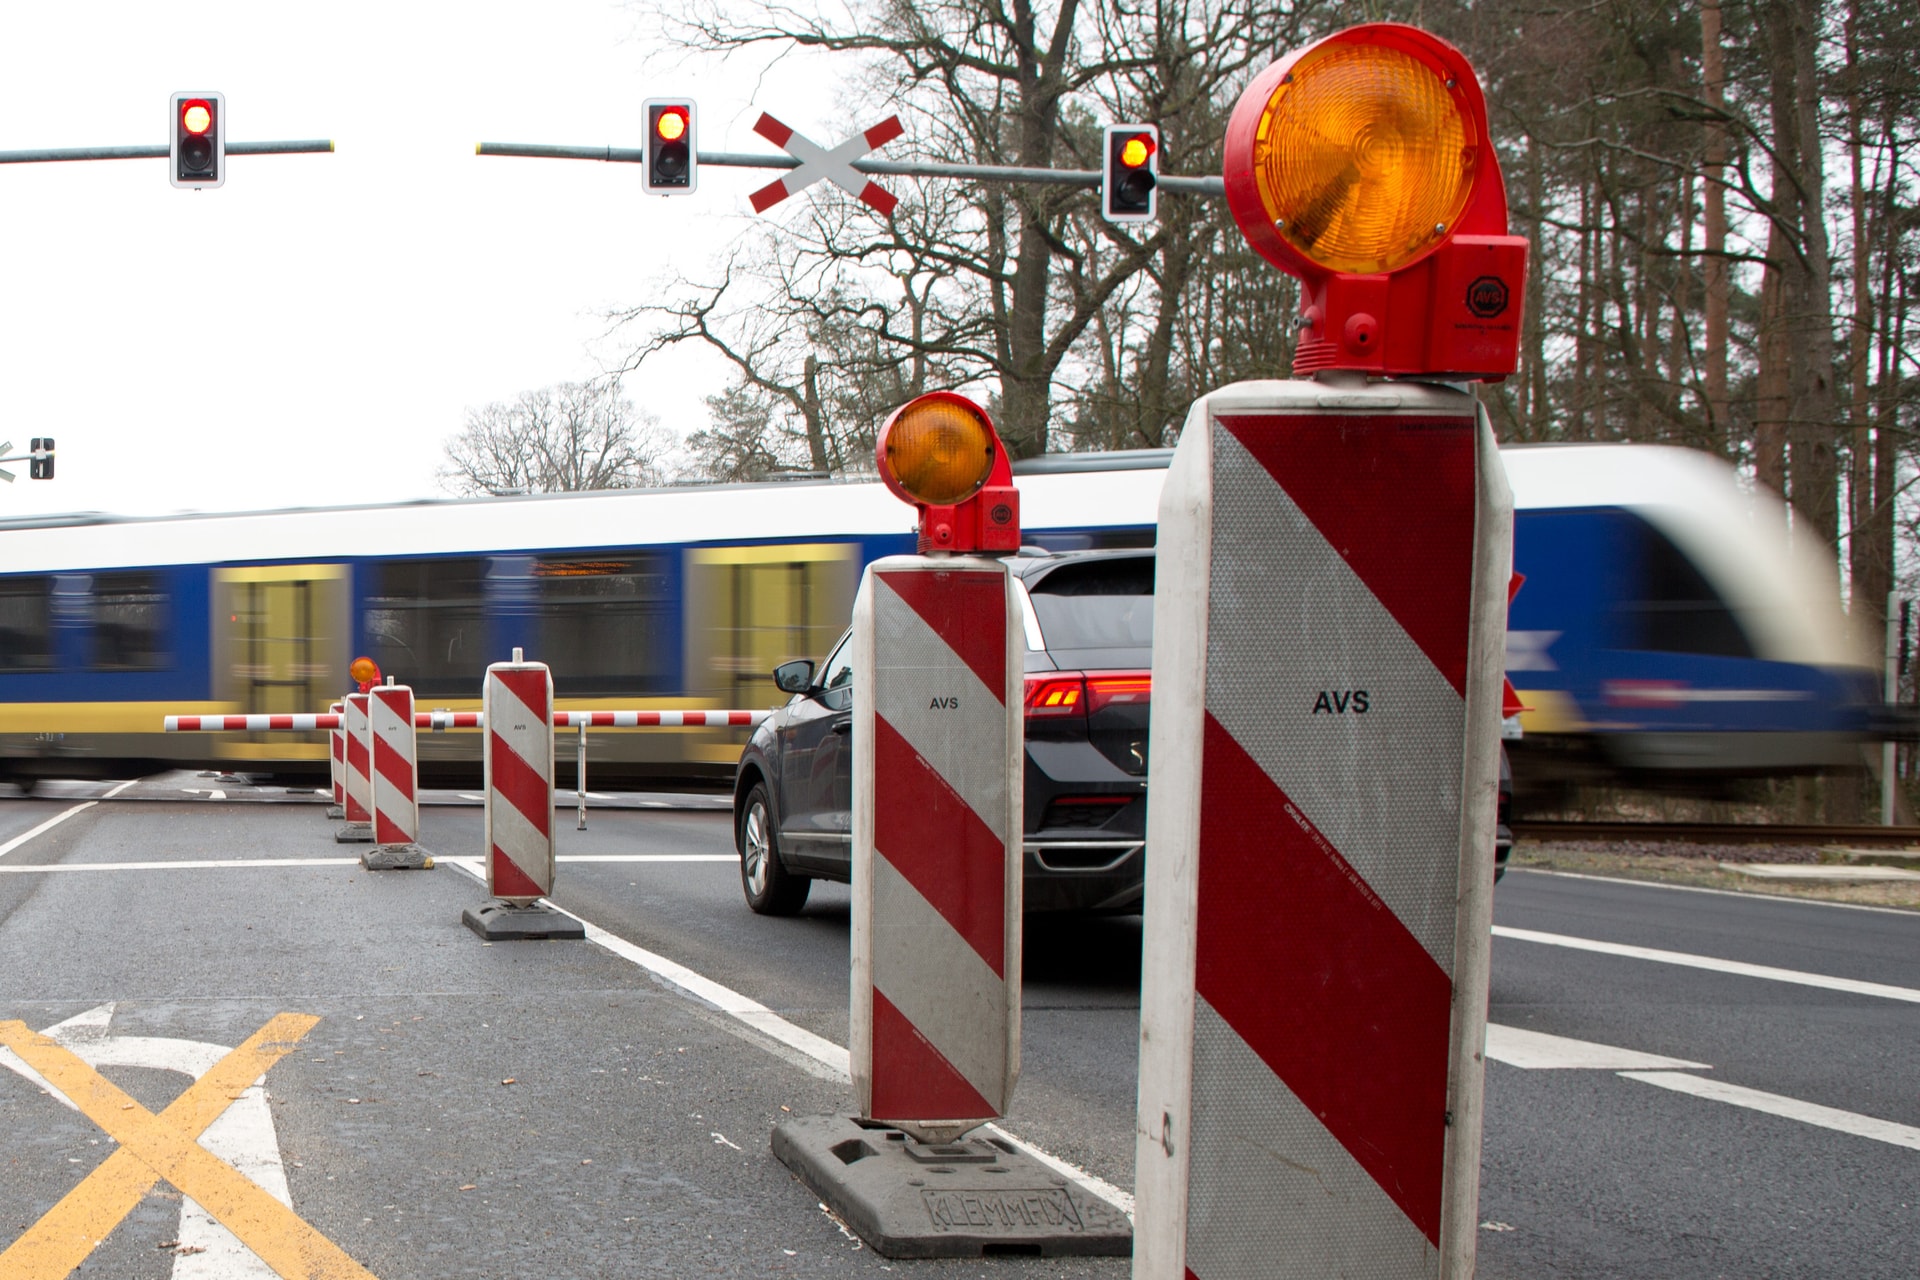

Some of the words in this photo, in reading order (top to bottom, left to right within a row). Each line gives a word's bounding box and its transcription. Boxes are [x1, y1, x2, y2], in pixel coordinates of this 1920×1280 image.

[1475, 290, 1500, 304] AVS
[930, 697, 958, 710] AVS
[1312, 690, 1369, 714] AVS
[925, 1197, 1079, 1226] KLEMMFIX
